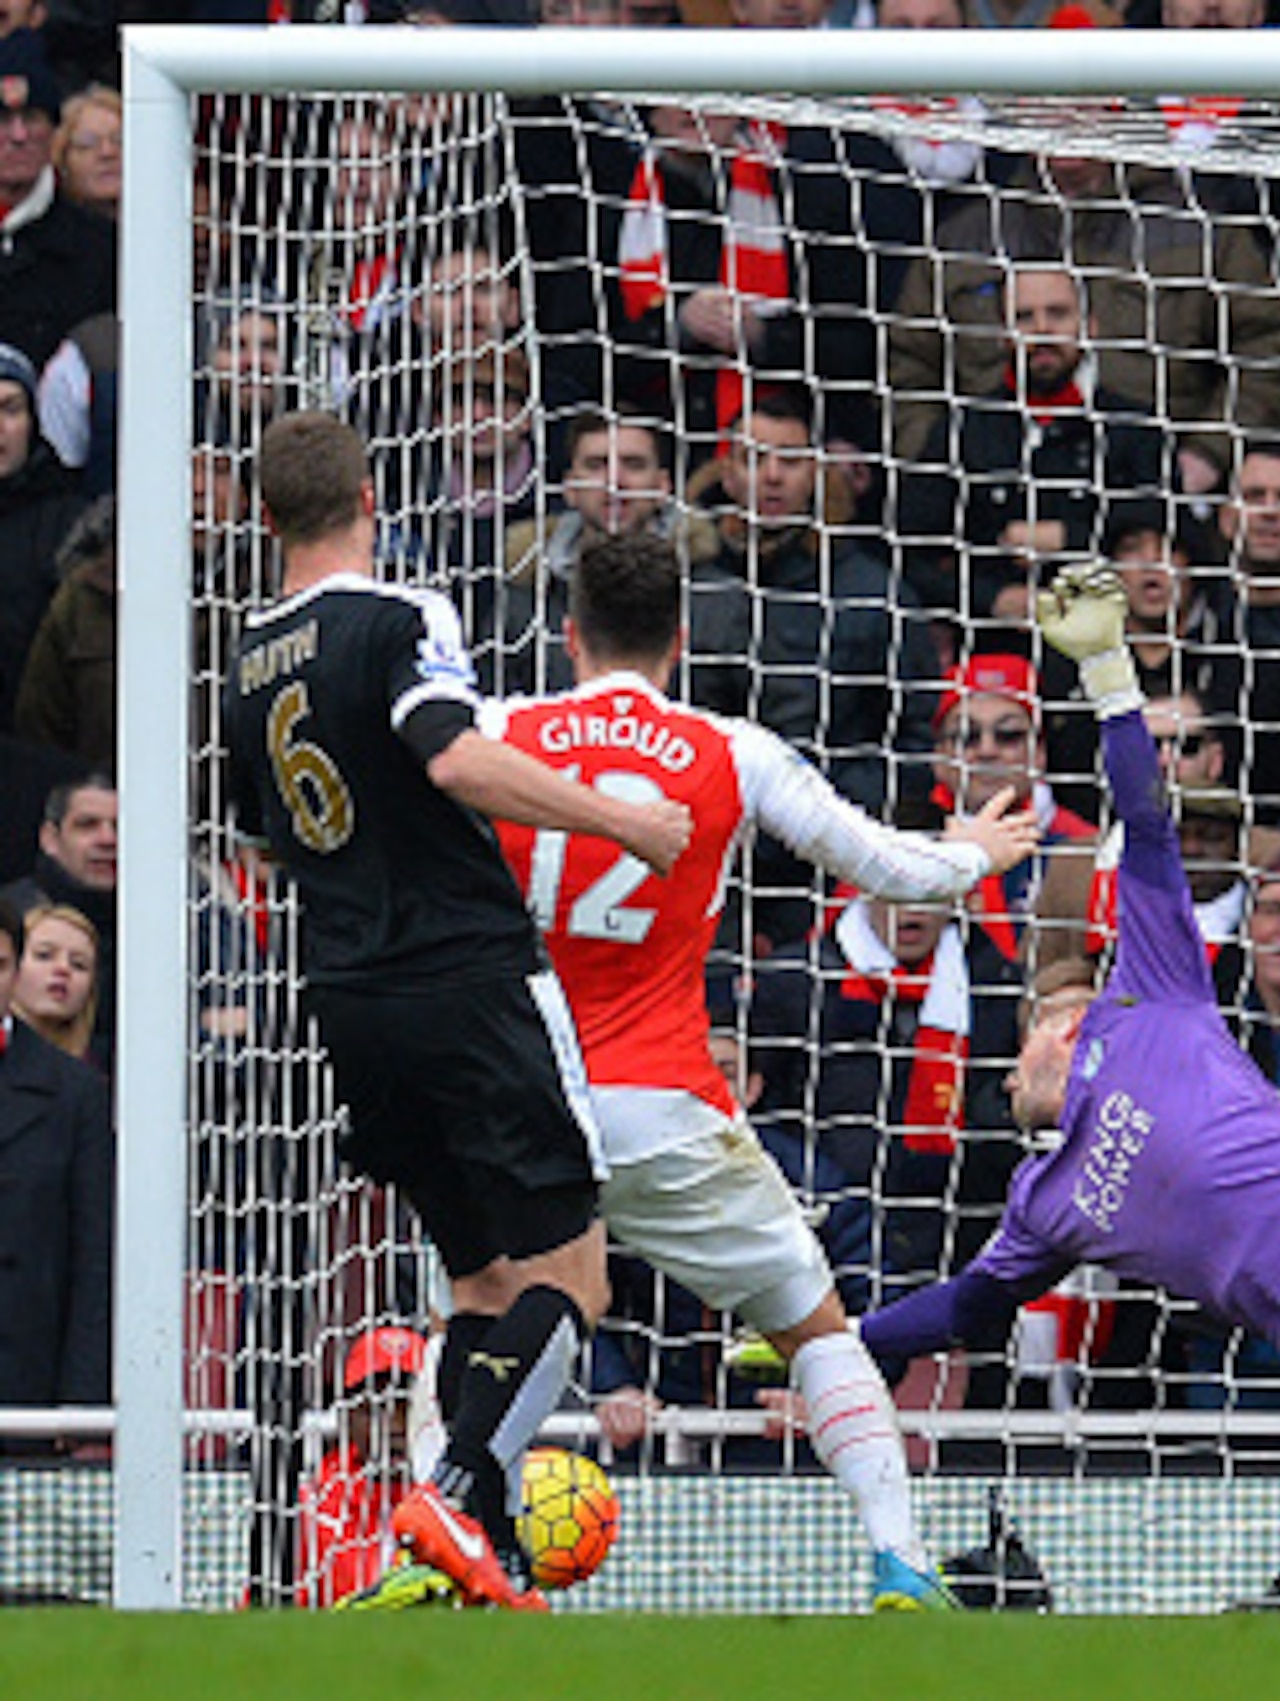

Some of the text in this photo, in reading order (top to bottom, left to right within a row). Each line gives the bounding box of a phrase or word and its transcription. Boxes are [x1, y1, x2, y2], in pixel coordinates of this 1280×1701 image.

[266, 679, 355, 854] 6
[539, 713, 696, 773] GIROUD
[526, 763, 659, 944] 12
[1072, 1089, 1134, 1217] KING
